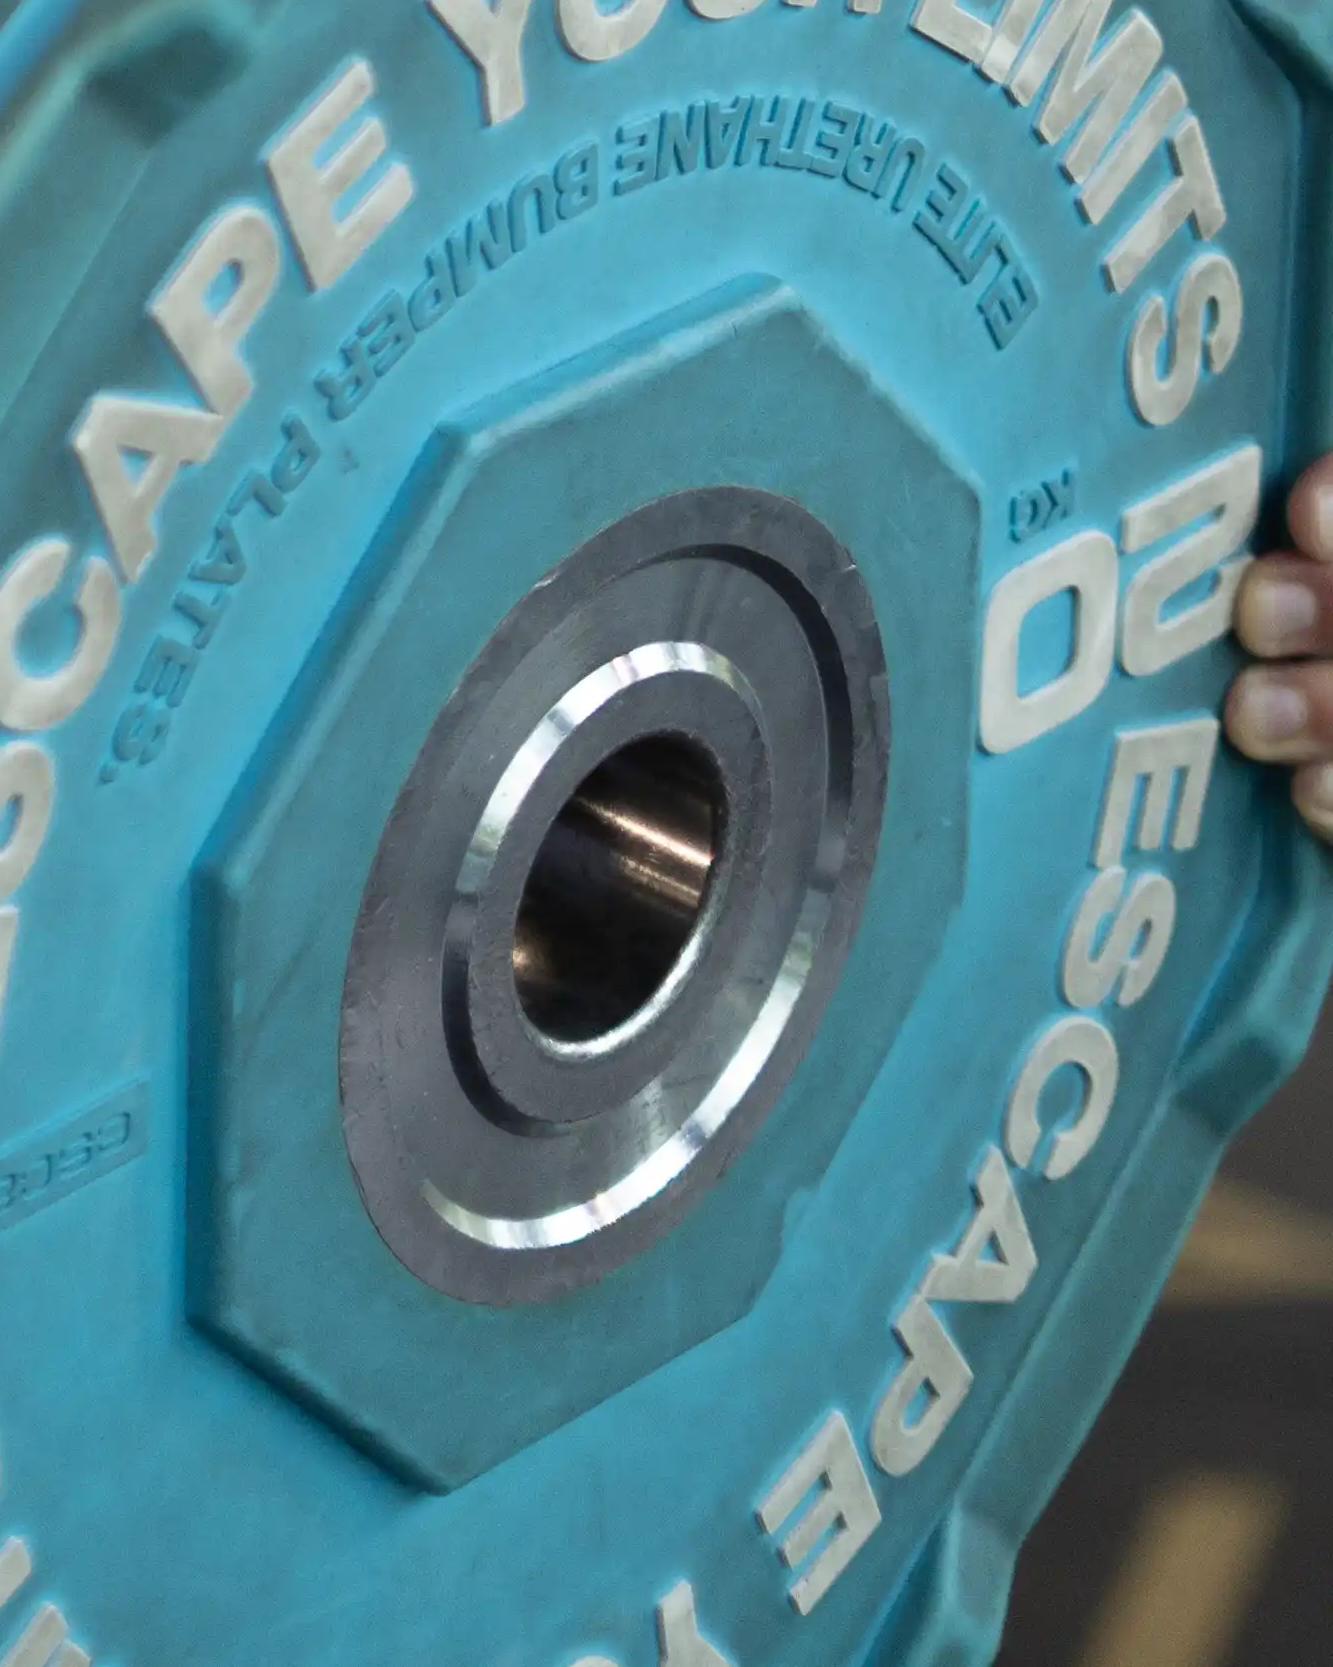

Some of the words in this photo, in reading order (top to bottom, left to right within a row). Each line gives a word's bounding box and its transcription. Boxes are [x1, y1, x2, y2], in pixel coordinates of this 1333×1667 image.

[613, 95, 929, 215] URETHANE
[913, 163, 1041, 352] ELITE
[313, 140, 600, 422] BUMPER
[754, 716, 1220, 1618] ESCAPE
